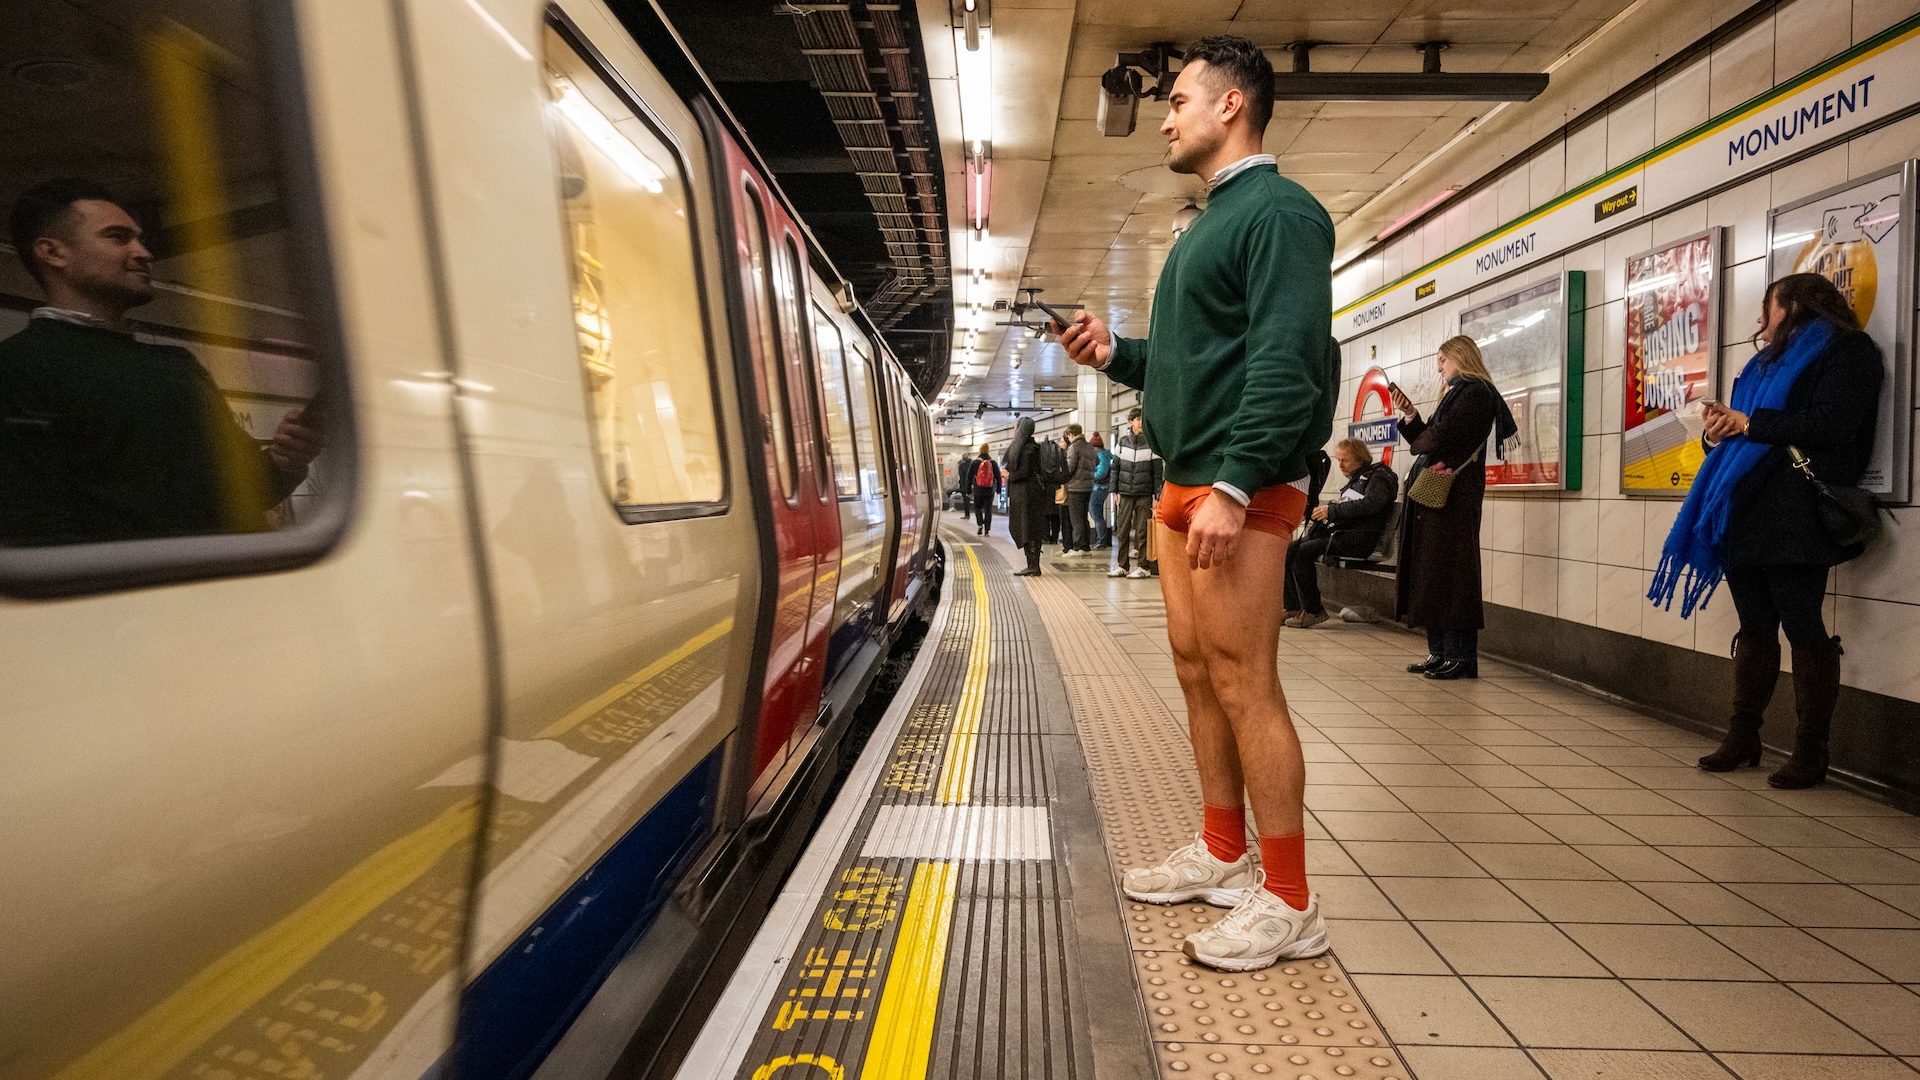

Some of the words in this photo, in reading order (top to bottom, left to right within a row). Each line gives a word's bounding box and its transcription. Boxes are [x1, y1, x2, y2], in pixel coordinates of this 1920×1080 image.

[1728, 74, 1875, 166] MONUMENT
[1602, 201, 1616, 214] Way
[1617, 197, 1629, 206] out
[1475, 232, 1536, 275] MONUMENT
[1832, 268, 1853, 289] OUT
[1353, 302, 1386, 328] MONUMENT
[1643, 302, 1700, 370] CLOSING
[1643, 365, 1686, 412] DOORS
[1354, 423, 1392, 442] MONUMENT
[823, 867, 904, 932] GAP
[772, 947, 882, 1031] THE
